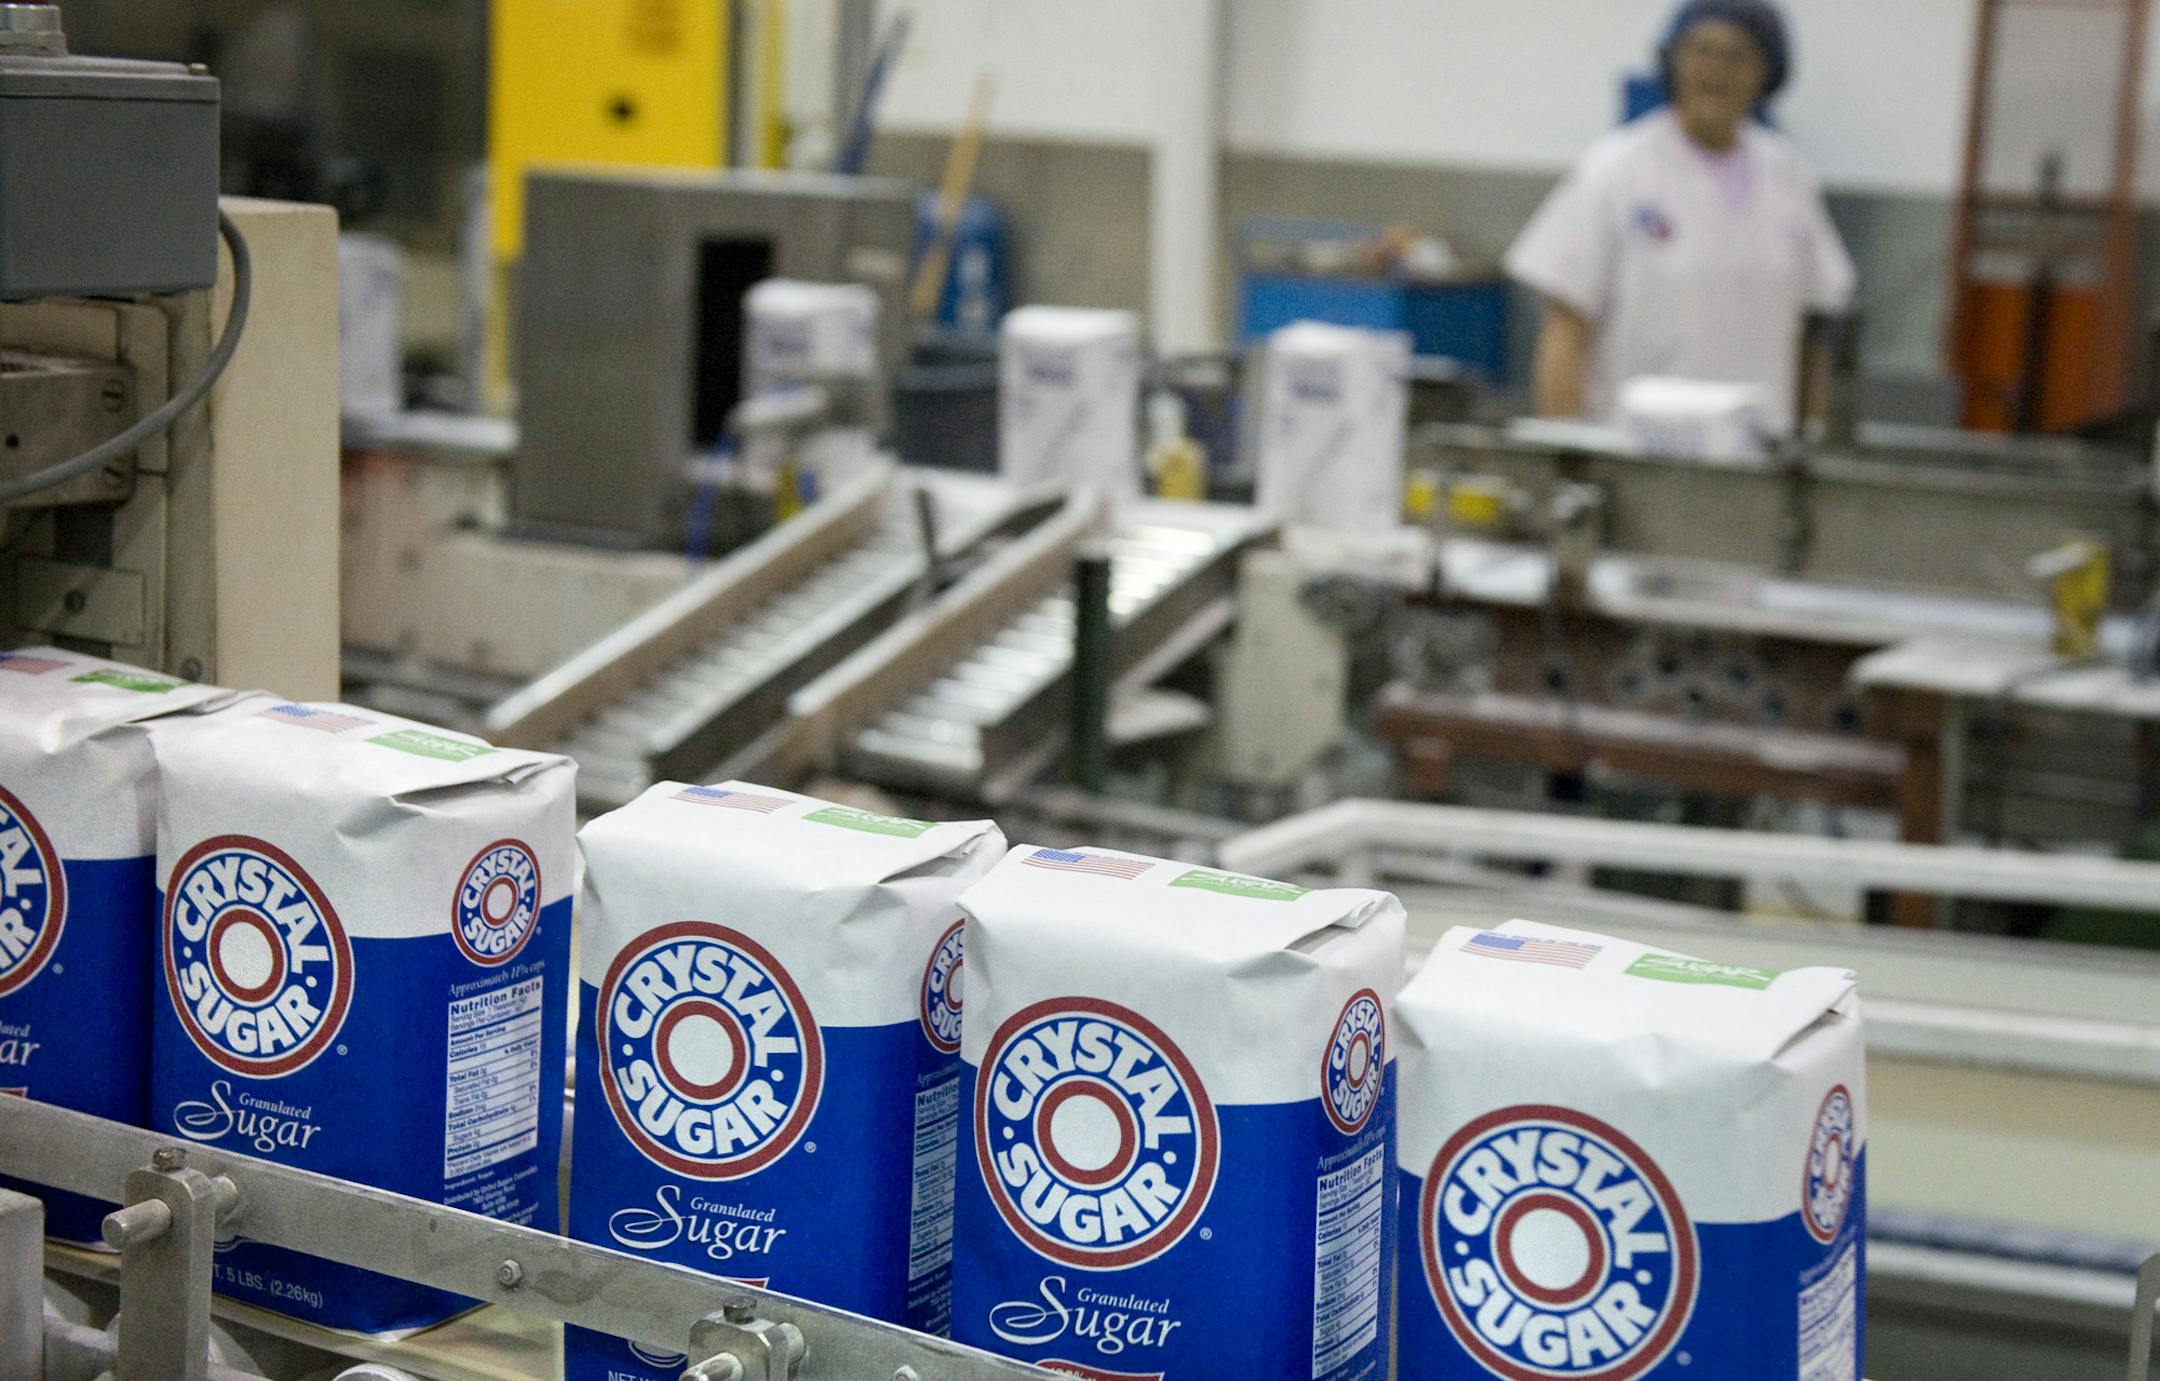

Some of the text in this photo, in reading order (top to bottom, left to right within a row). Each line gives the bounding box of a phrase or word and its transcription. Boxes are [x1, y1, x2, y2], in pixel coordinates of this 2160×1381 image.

[463, 849, 535, 909] CRYSTAL
[176, 856, 330, 974] CRYSTAL
[464, 904, 531, 954] SUGAR
[930, 929, 965, 993] CRYS
[180, 961, 321, 1054] SUGAR
[450, 993, 507, 1016] Nutrition
[511, 981, 540, 999] Facts
[614, 944, 799, 1068] CRYSTAL
[931, 1001, 963, 1038] SUG
[1332, 1000, 1381, 1071] CRYSTAL
[173, 1080, 321, 1152] Sugar
[239, 1091, 312, 1119] Granulated
[617, 1058, 788, 1155] SUGAR
[993, 1020, 1192, 1150] CRYSTAL
[1332, 1062, 1378, 1120] SUGAR
[997, 1142, 1182, 1243] SUGAR
[1319, 1164, 1362, 1192] Nutrition
[1363, 1150, 1383, 1170] Facts
[1443, 1129, 1669, 1269] CRYSTAL
[608, 1184, 787, 1260] Sugar
[690, 1196, 777, 1223] Granulated
[213, 1263, 324, 1309] T. 5 LBS. (2.26kg)
[989, 1275, 1182, 1355] Sugar
[1077, 1287, 1170, 1314] Granulated
[1449, 1258, 1657, 1367] SUGAR
